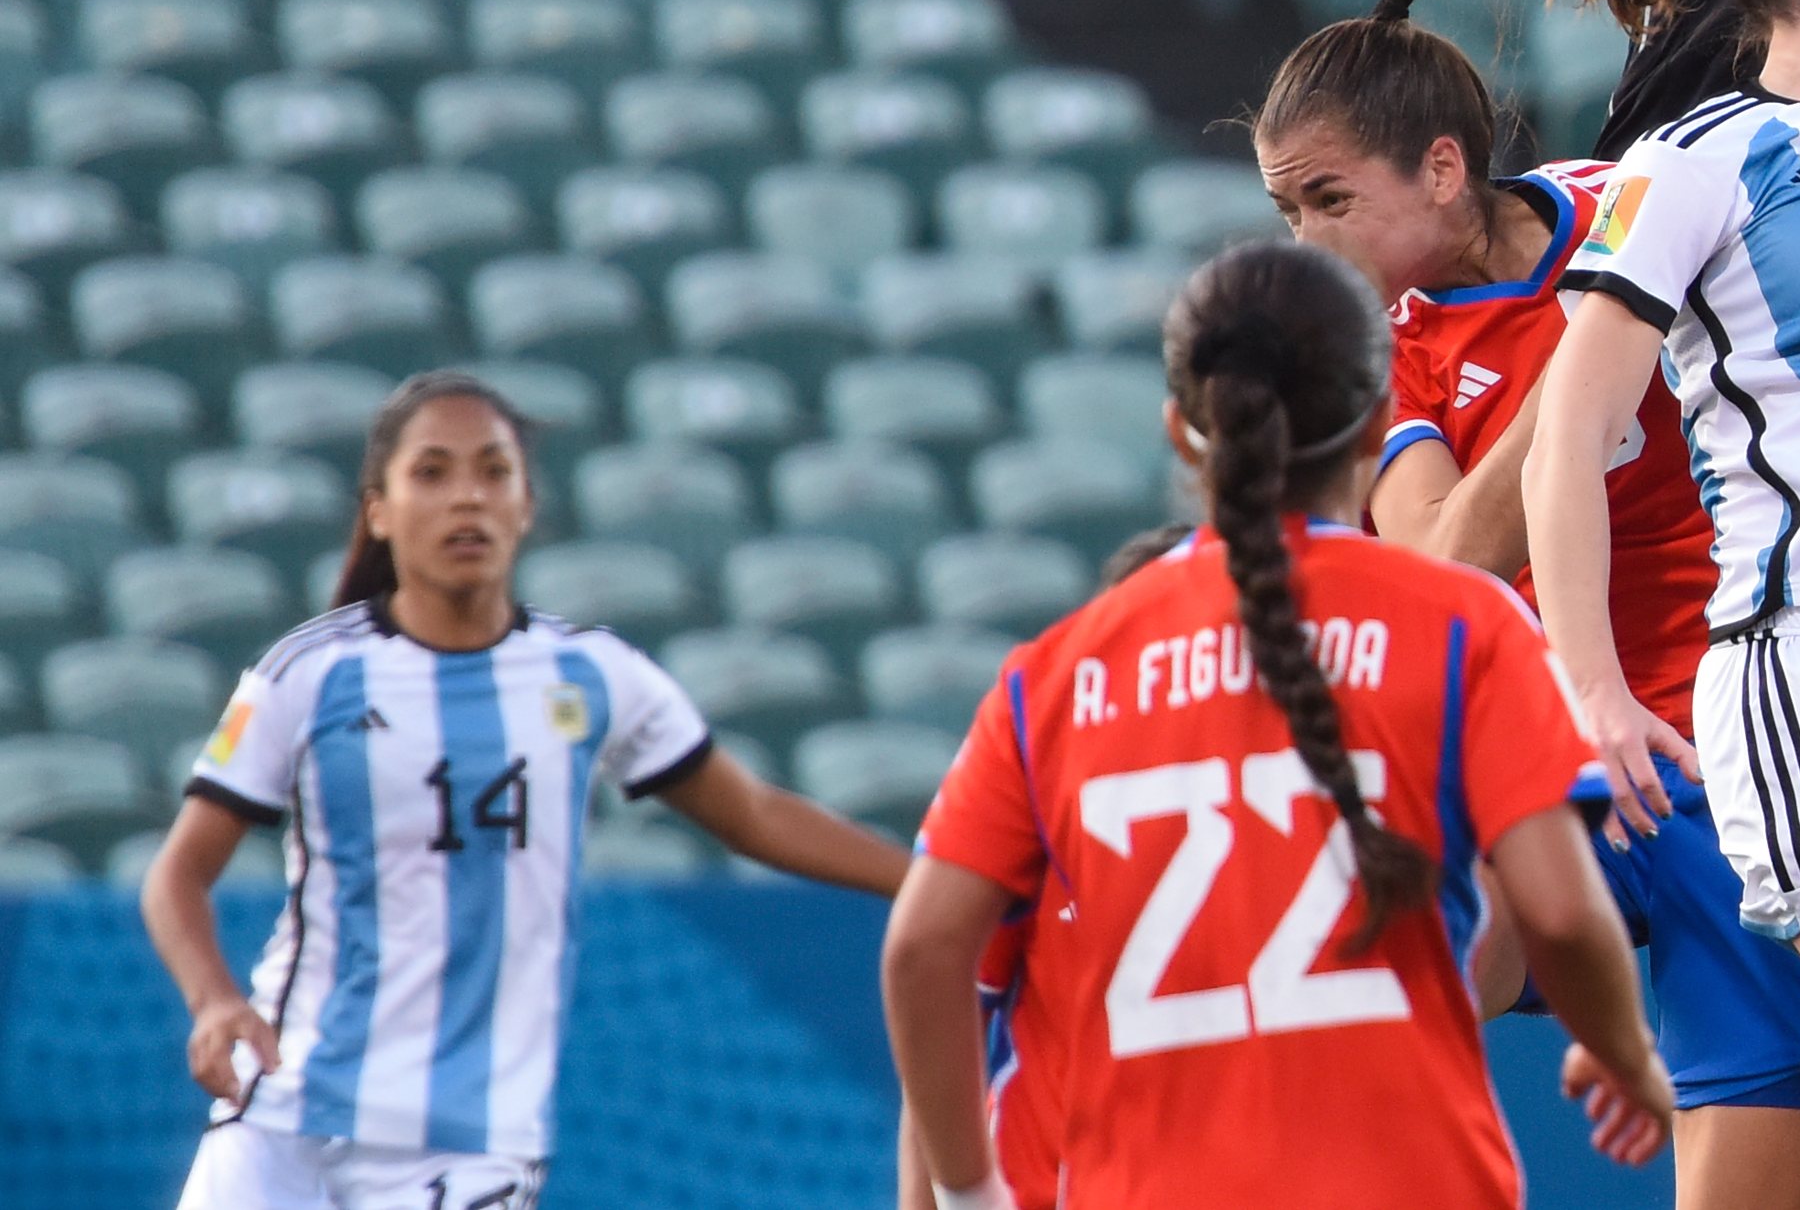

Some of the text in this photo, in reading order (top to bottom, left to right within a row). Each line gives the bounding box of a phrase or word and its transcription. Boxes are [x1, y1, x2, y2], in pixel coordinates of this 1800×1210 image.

[1074, 617, 1389, 729] A. FIGUOA
[425, 756, 529, 852] 14
[1080, 747, 1411, 1060] 22
